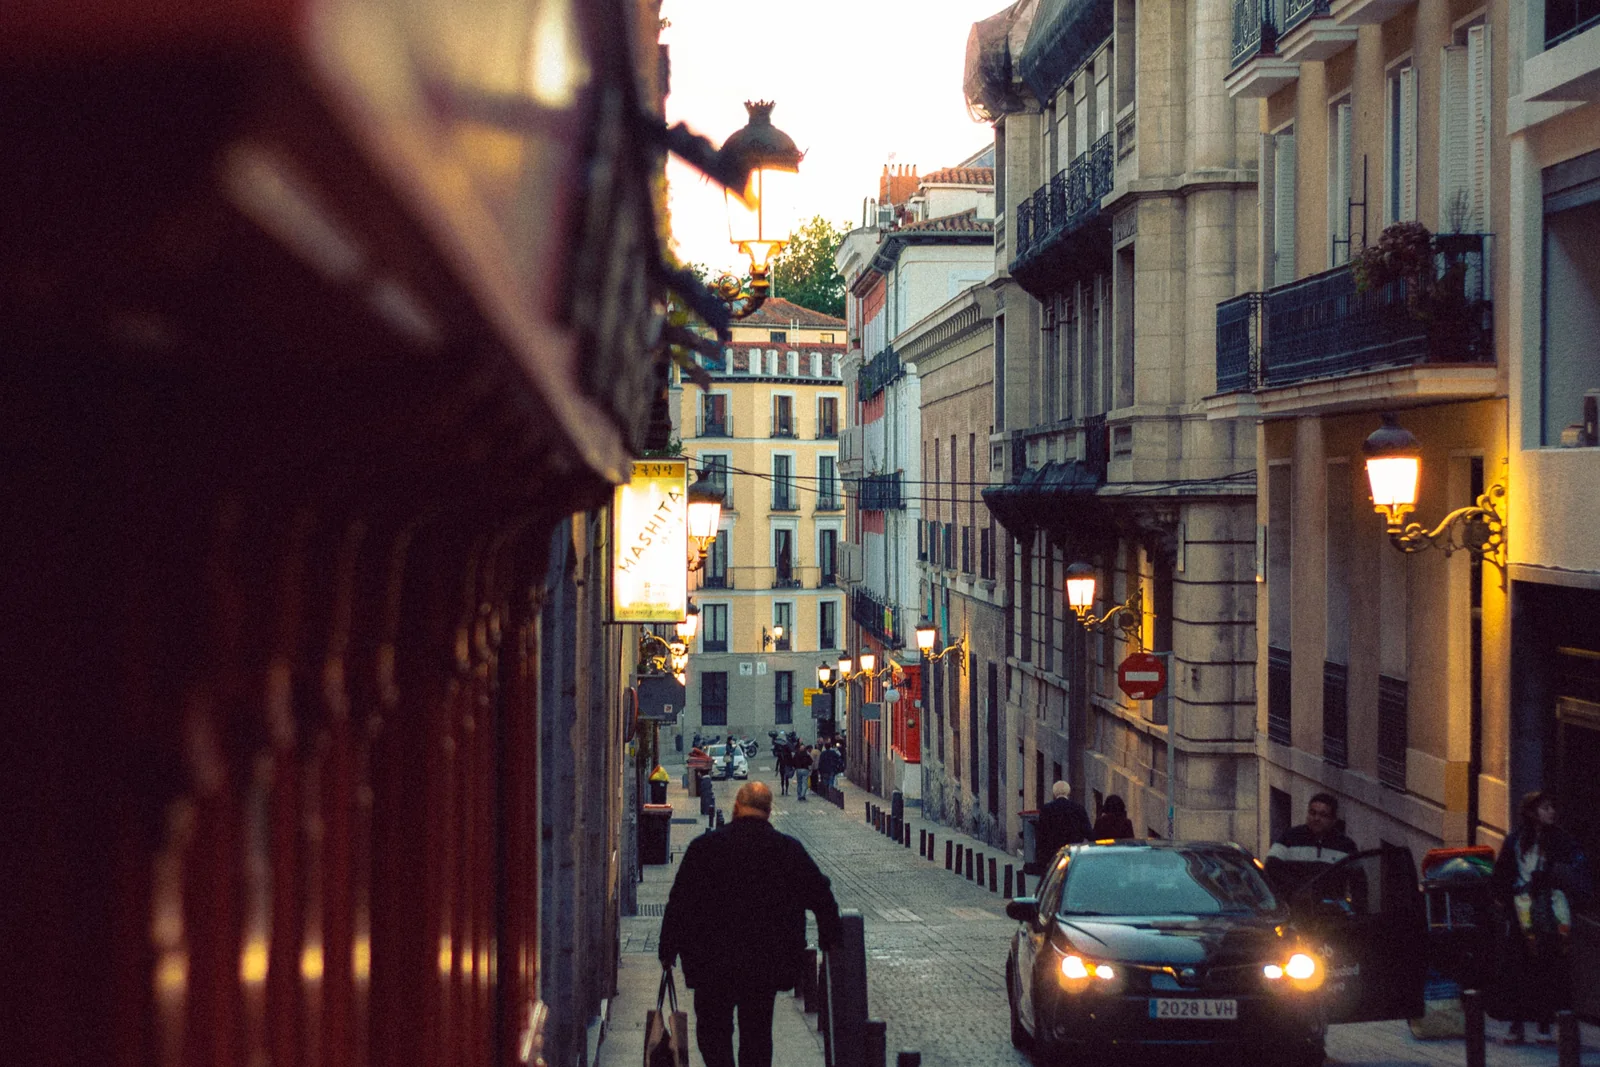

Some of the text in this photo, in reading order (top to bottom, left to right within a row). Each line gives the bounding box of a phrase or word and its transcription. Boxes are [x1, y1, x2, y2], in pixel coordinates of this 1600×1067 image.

[618, 491, 684, 573] MASHITA
[1160, 1001, 1234, 1016] 2028 LVH
